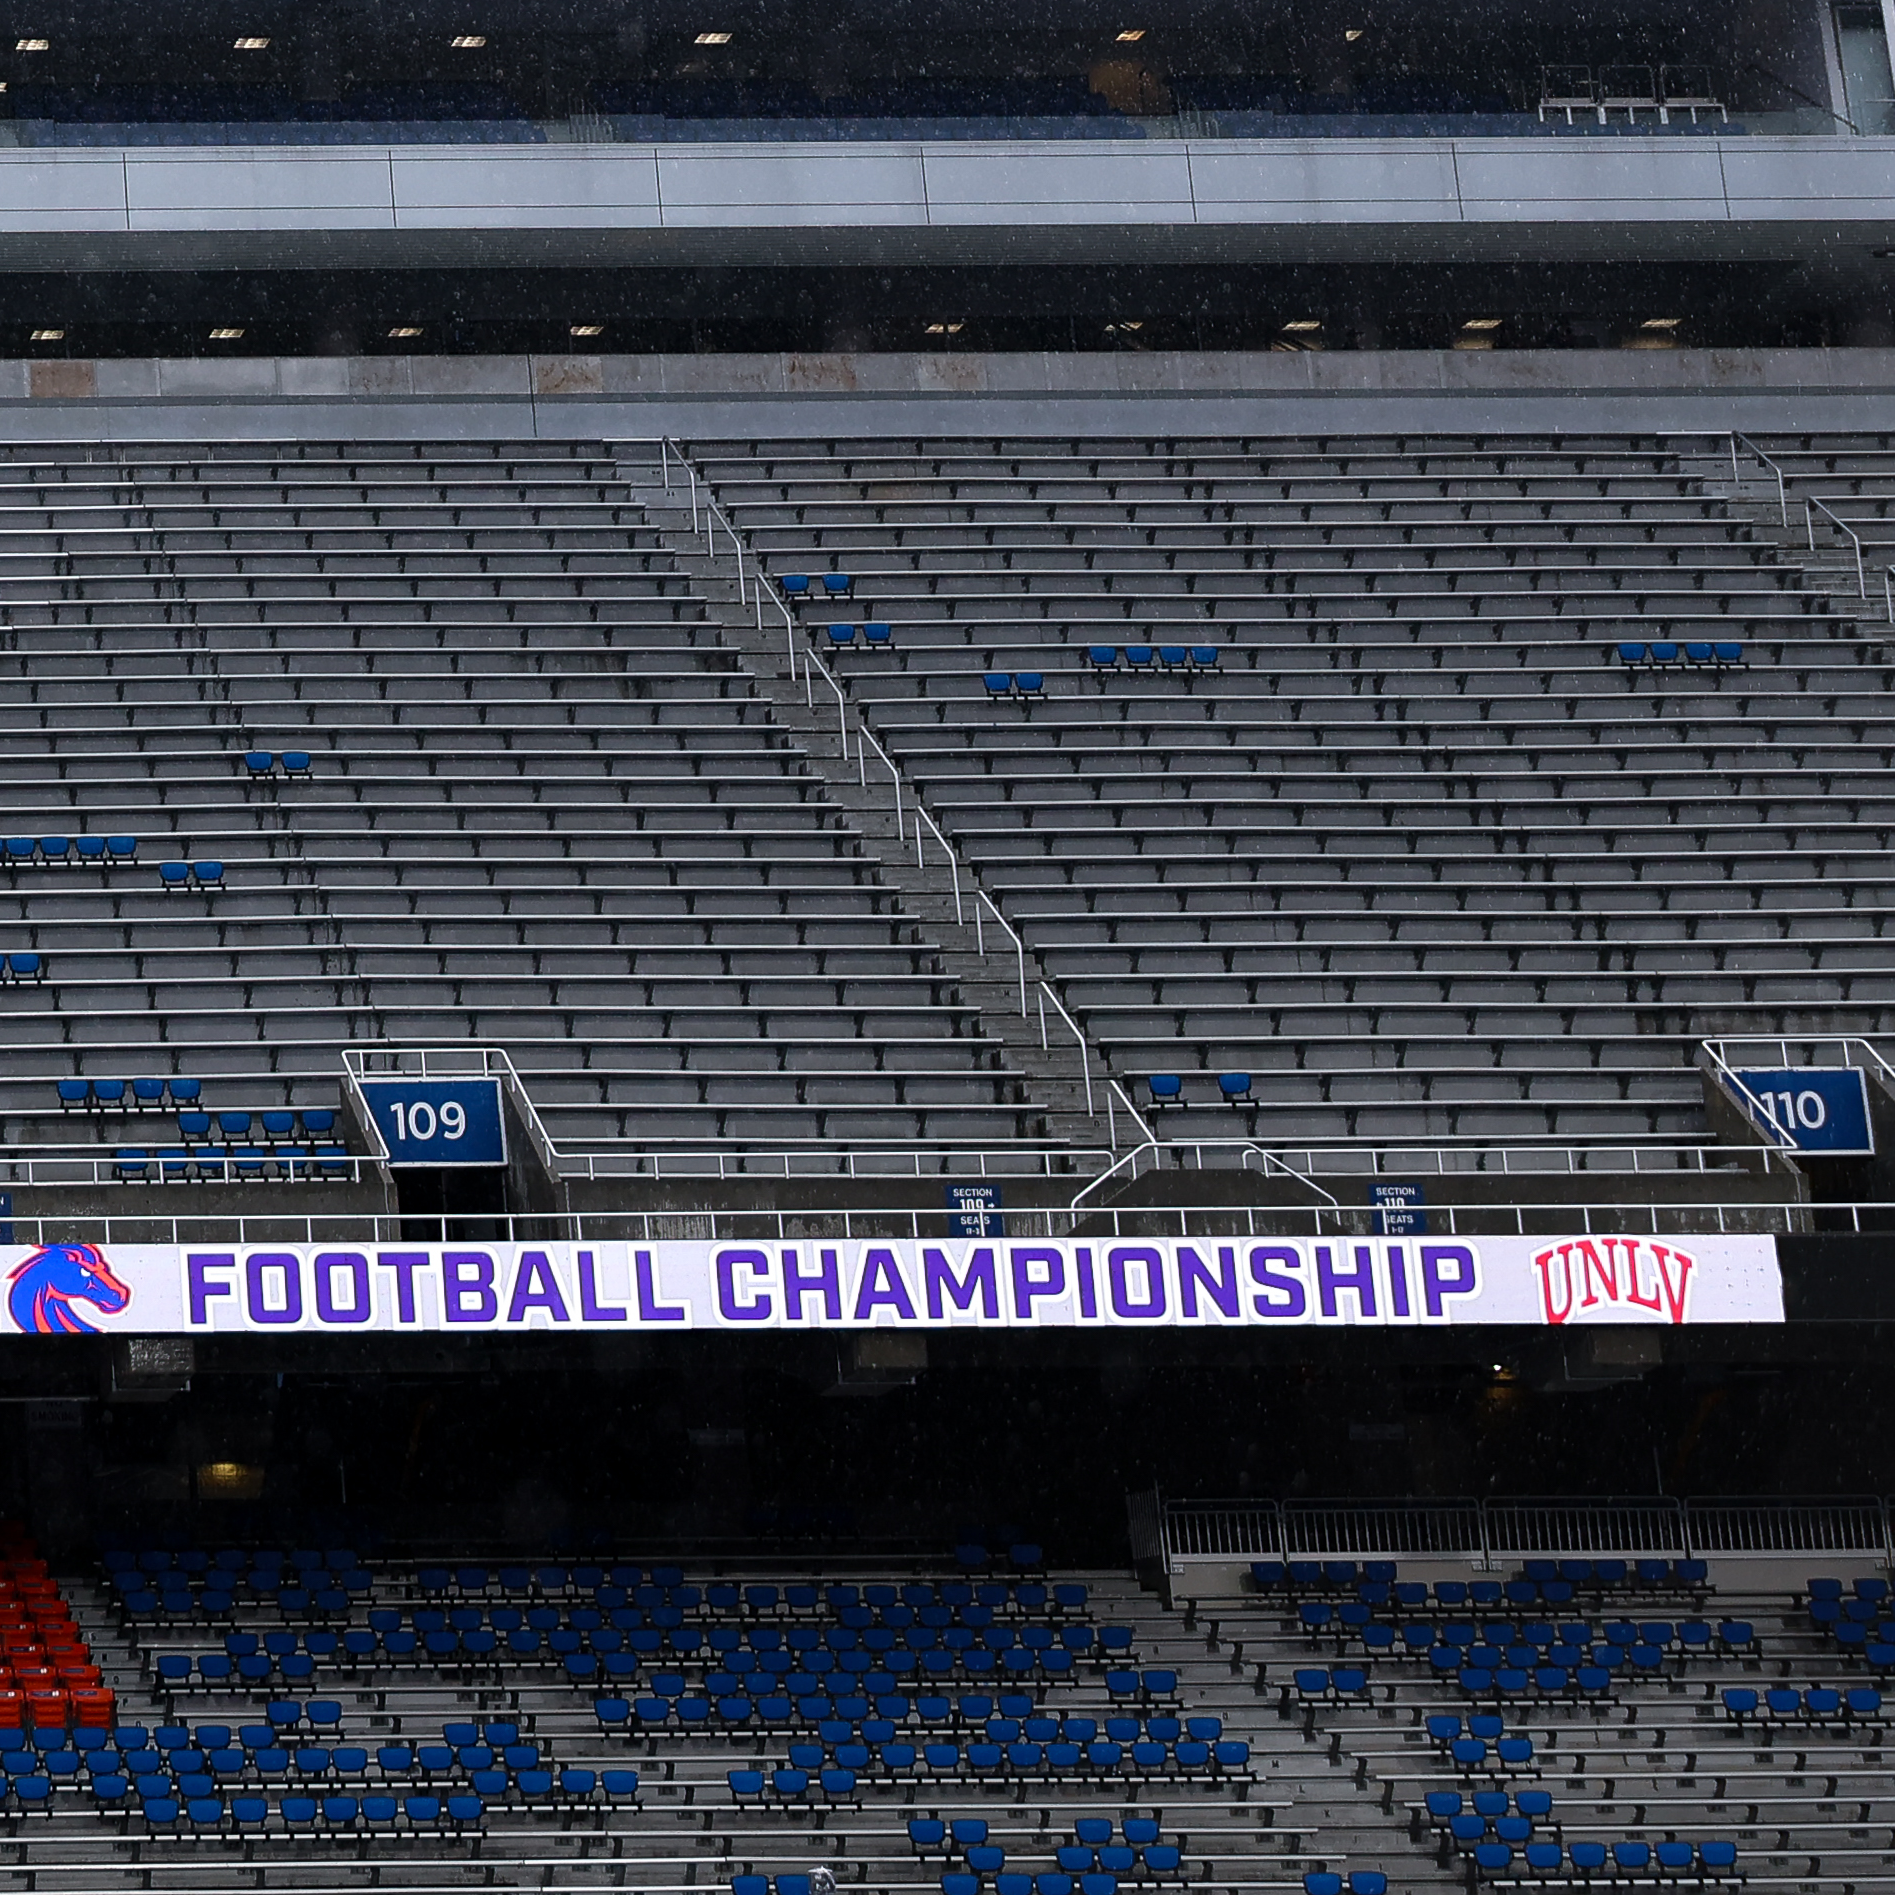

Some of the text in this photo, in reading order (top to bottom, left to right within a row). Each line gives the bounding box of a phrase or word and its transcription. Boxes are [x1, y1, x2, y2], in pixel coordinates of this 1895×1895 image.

[390, 1102, 467, 1142] 109
[1760, 1090, 1826, 1129] 110
[953, 1188, 993, 1197] SECTION
[1375, 1187, 1416, 1196] SECTION
[960, 1216, 991, 1225] SEAS
[189, 1245, 1475, 1324] FOOTBALL CHAMPIONSHIP
[1535, 1238, 1693, 1325] UNLV
